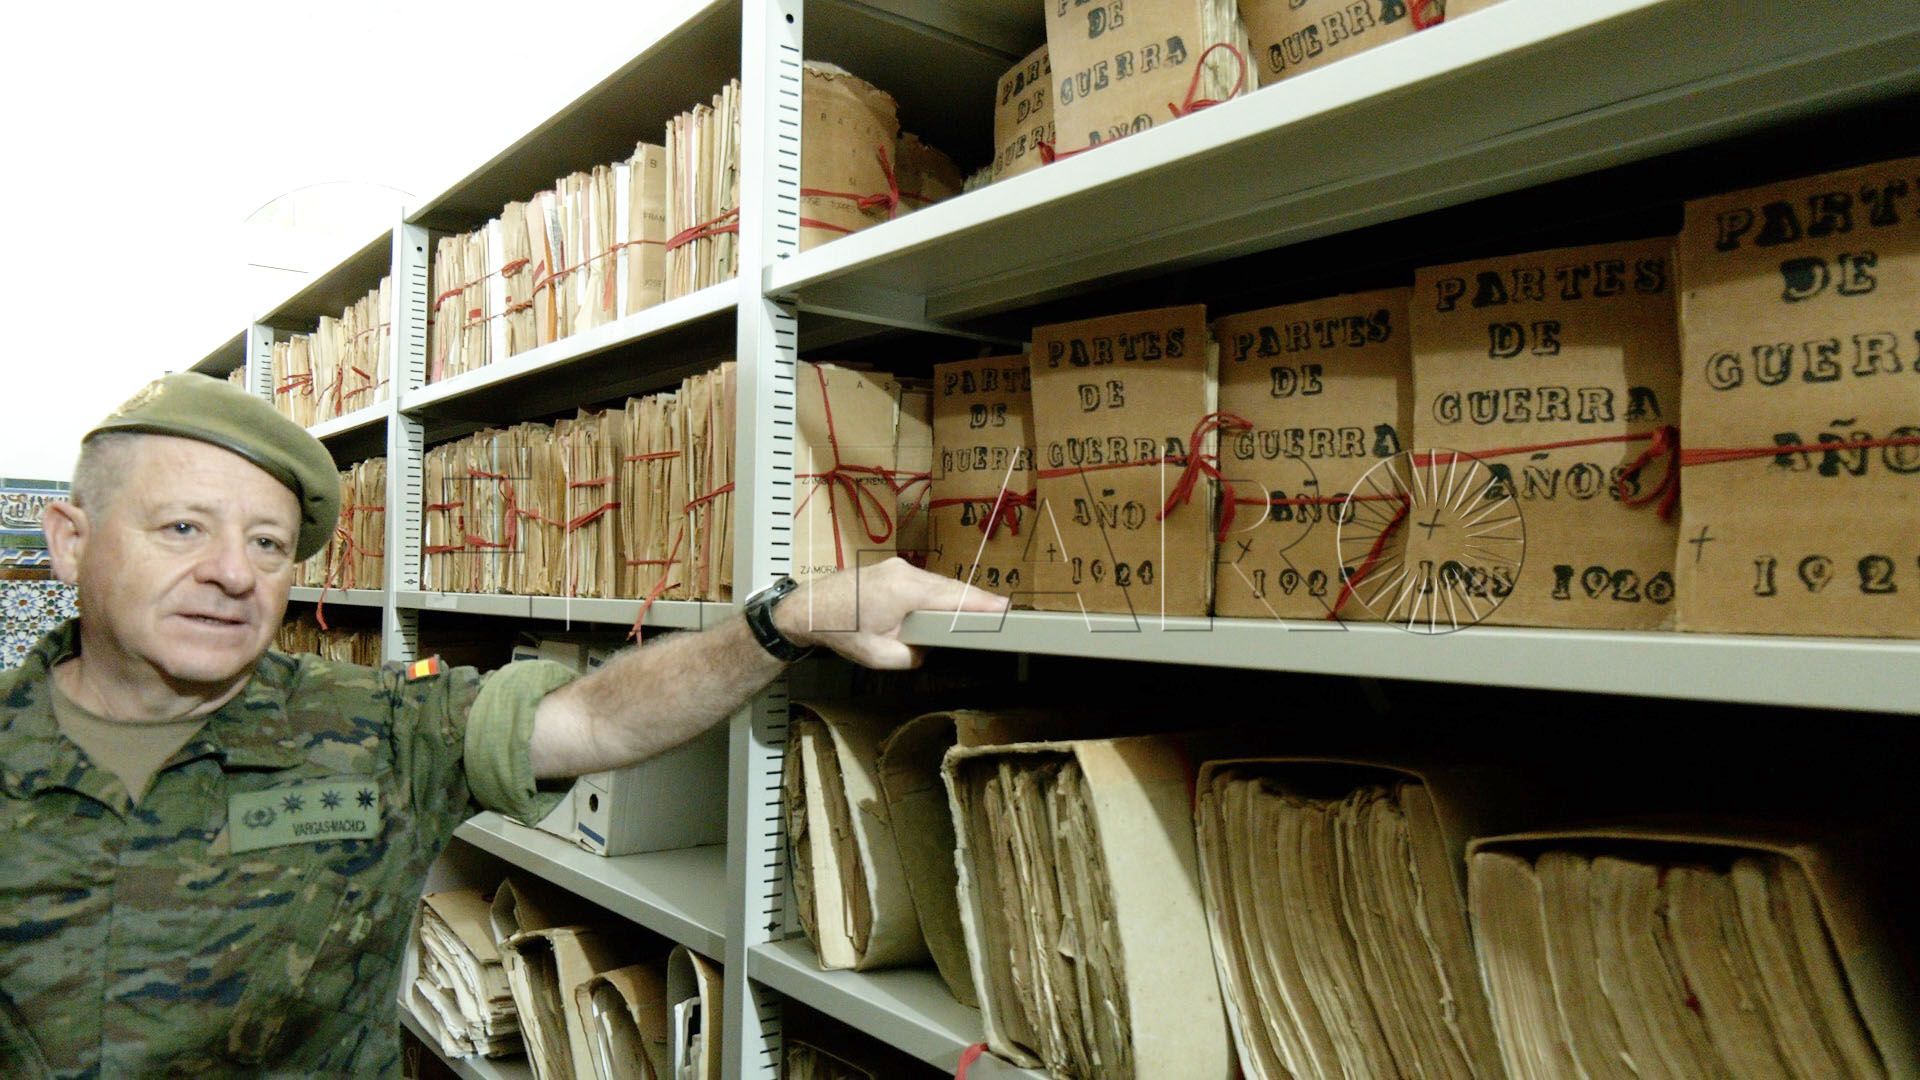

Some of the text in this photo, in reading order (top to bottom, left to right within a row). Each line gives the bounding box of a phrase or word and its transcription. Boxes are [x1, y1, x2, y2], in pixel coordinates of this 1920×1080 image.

[1088, 3, 1125, 39] DE
[1267, 0, 1406, 74] GUERRA
[1060, 35, 1188, 106] GUERRA
[1017, 88, 1044, 124] DE
[1714, 176, 1920, 254] PART
[1434, 259, 1666, 312] PARTES
[1780, 250, 1878, 304] DE
[1048, 327, 1186, 368] PARTES
[1232, 308, 1393, 362] PARTES
[1488, 320, 1562, 359] DE
[1270, 363, 1323, 398] DE
[1706, 329, 1920, 392] GUER
[969, 403, 1007, 429] DE
[1078, 379, 1126, 412] DE
[1432, 386, 1664, 425] GUERRA
[1046, 437, 1189, 468] GUERRA
[1233, 423, 1401, 461] GUERRA
[1073, 489, 1147, 531] AÑO
[1754, 553, 1920, 598] 192
